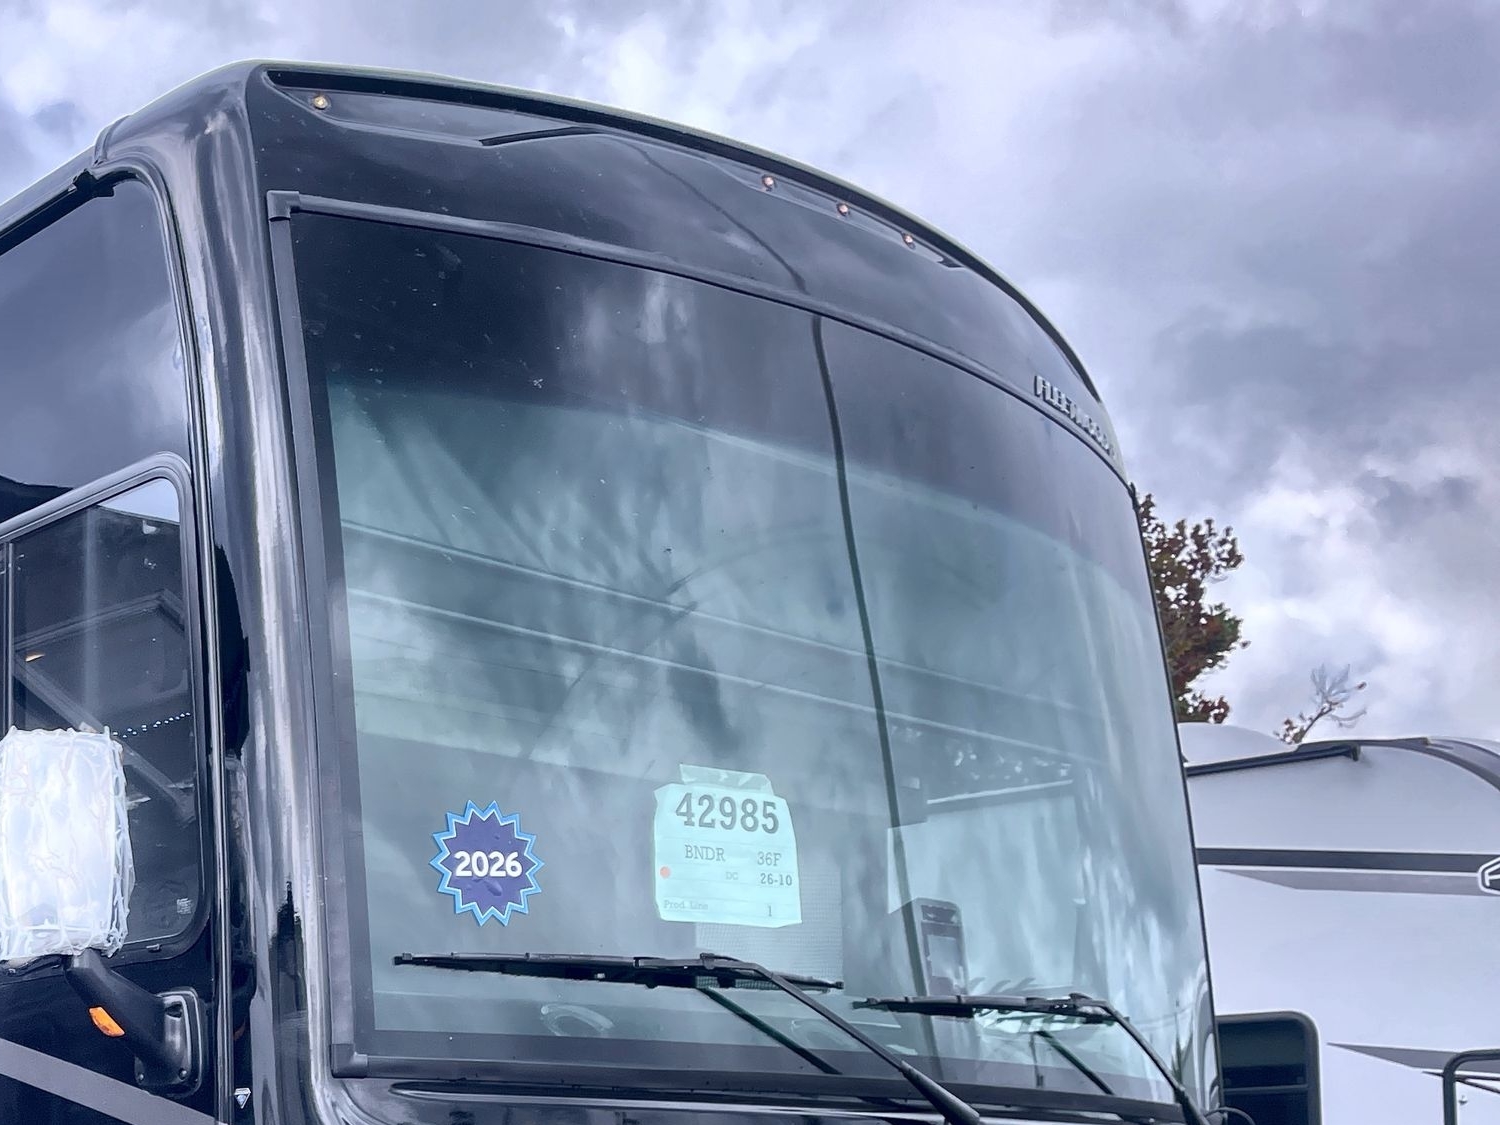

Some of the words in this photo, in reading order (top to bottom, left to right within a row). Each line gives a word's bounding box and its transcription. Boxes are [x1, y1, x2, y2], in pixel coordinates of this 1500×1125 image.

[675, 792, 779, 834] 42985
[454, 851, 522, 877] 2026
[684, 844, 726, 862] BNDR
[757, 851, 782, 866] 36F
[760, 873, 793, 886] 26-10
